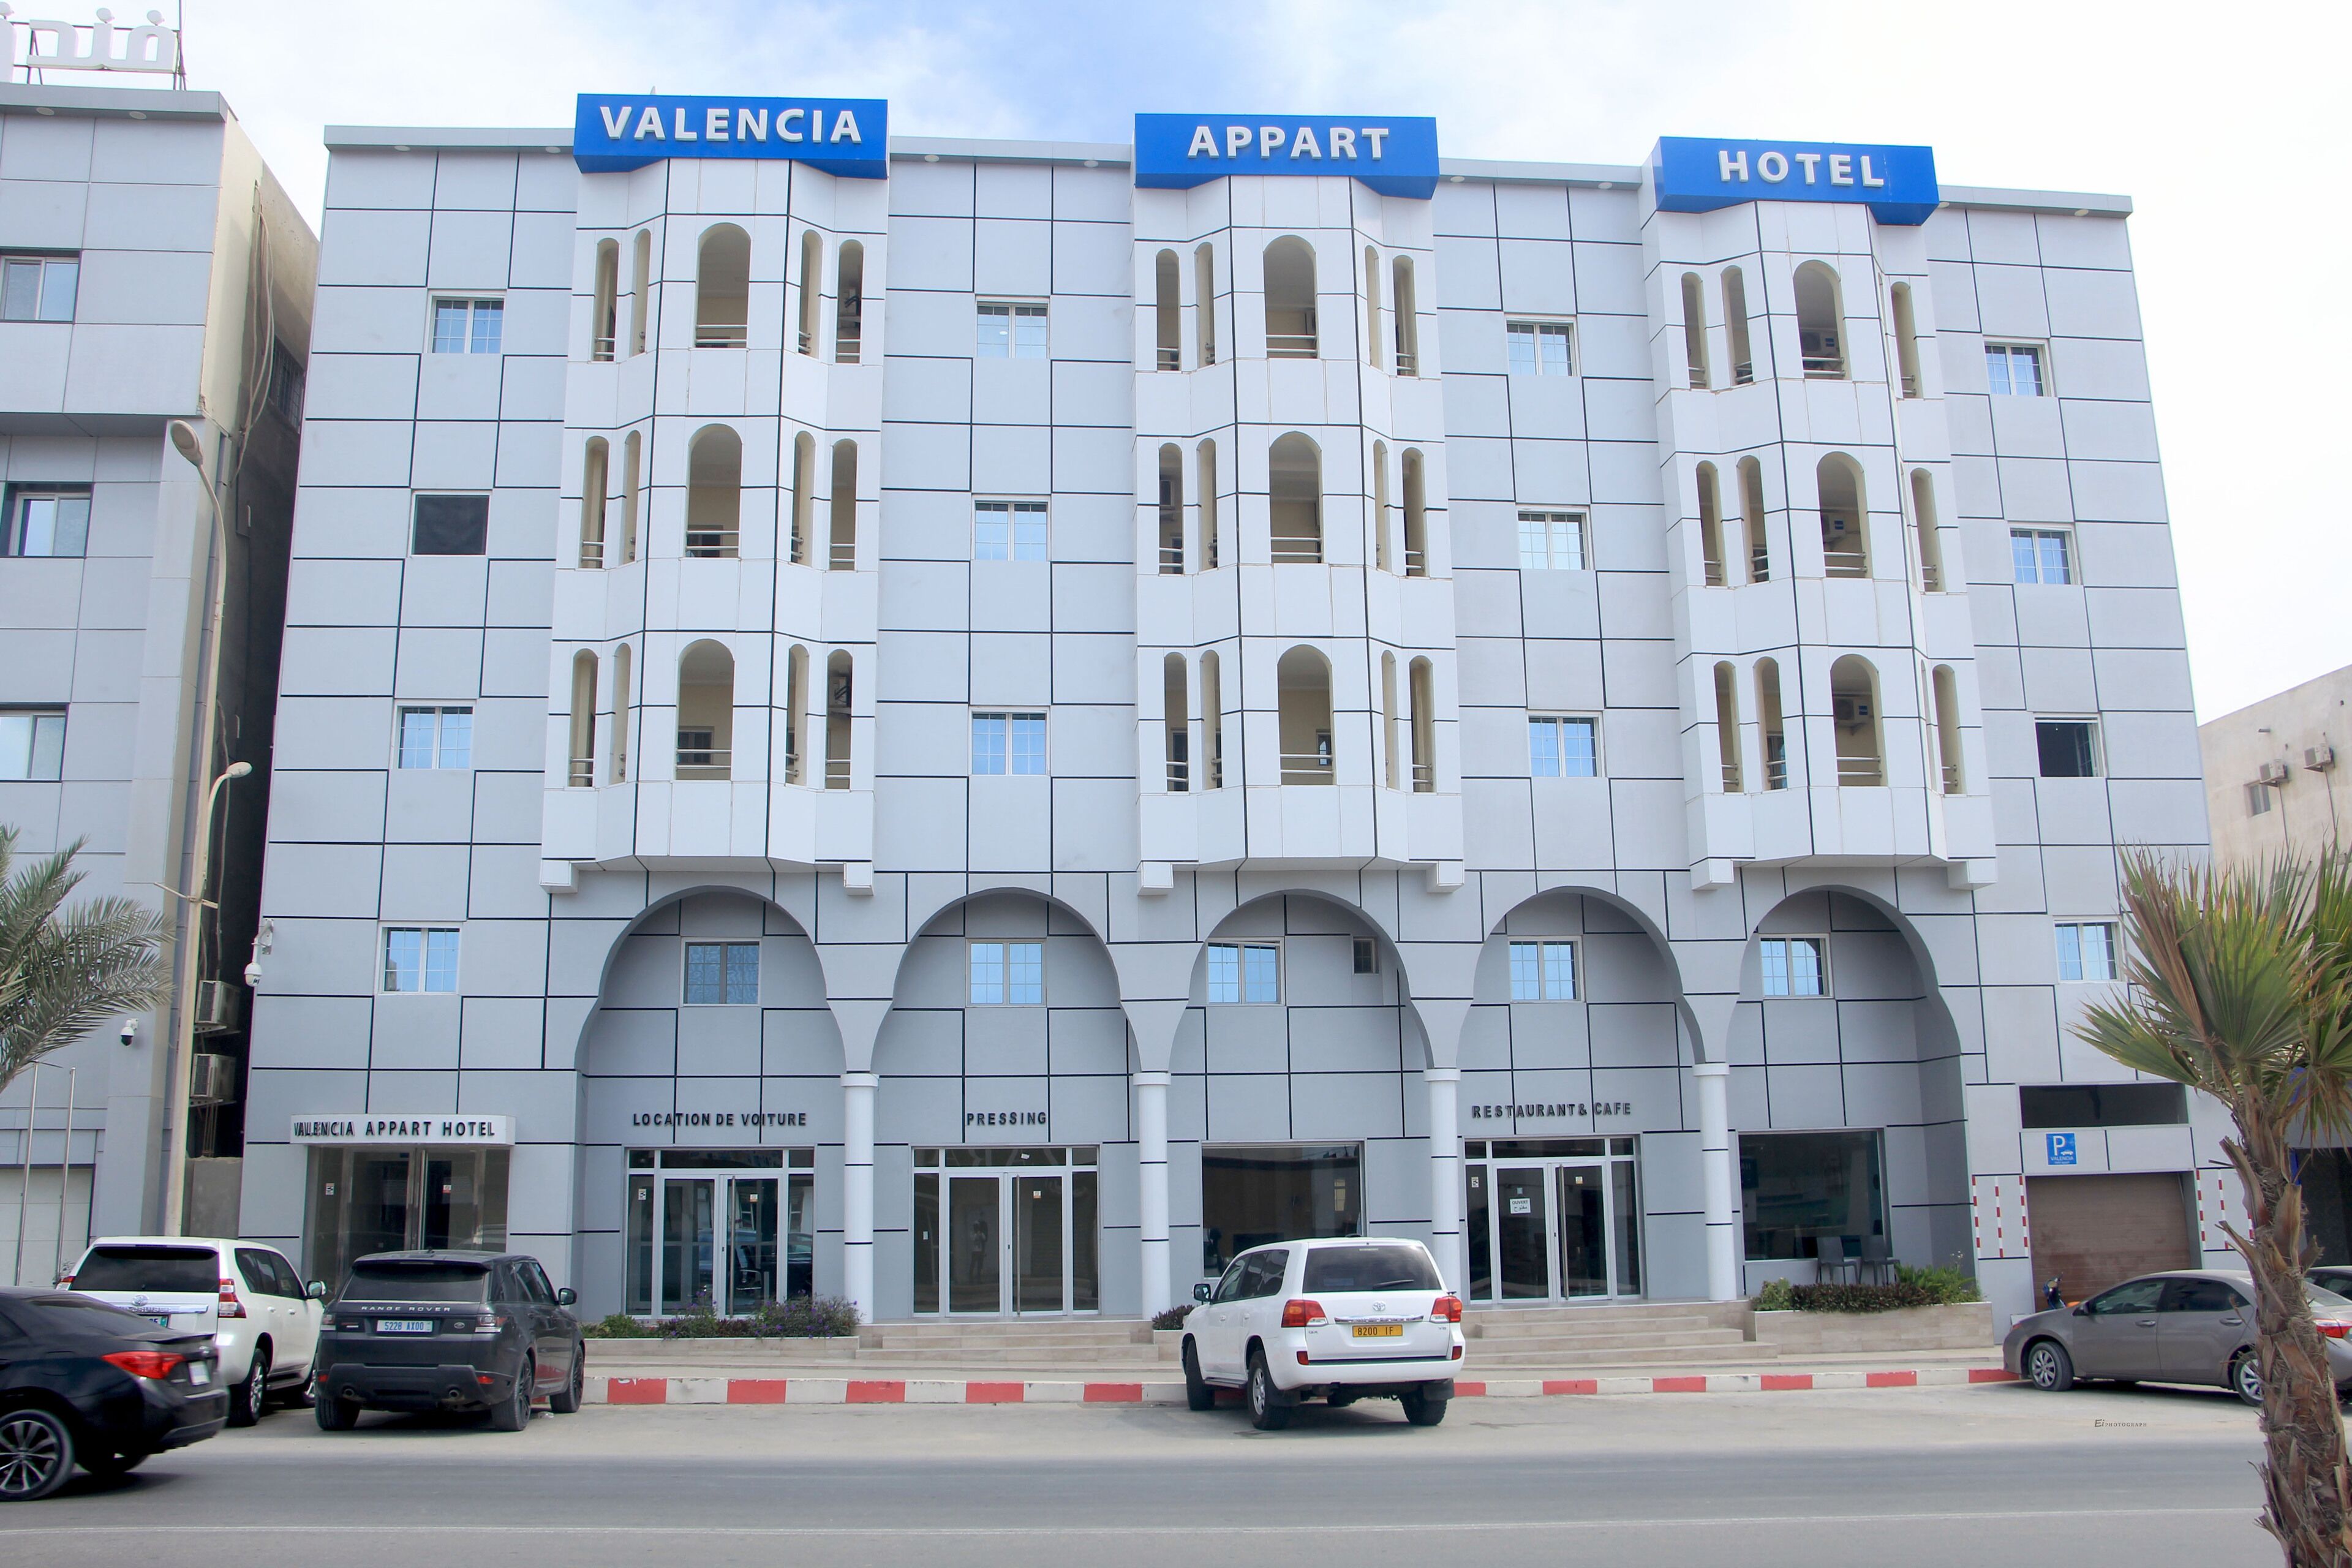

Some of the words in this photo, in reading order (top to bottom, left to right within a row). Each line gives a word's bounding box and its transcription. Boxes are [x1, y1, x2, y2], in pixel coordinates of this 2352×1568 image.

[600, 106, 862, 144] VALENCIA
[1187, 126, 1389, 160] APPART
[1718, 151, 1884, 187] HOTEL
[1594, 1102, 1631, 1115] CAFE
[633, 1112, 710, 1126] LOCATION
[715, 1113, 734, 1126] DE
[741, 1113, 807, 1126] VOITURE
[967, 1112, 1047, 1126] PRESSING
[293, 1121, 355, 1137] VALENCIA
[365, 1120, 431, 1137] APPART
[442, 1121, 496, 1136] HOTEL
[384, 1321, 402, 1331] 5228
[1357, 1326, 1378, 1336] 8200
